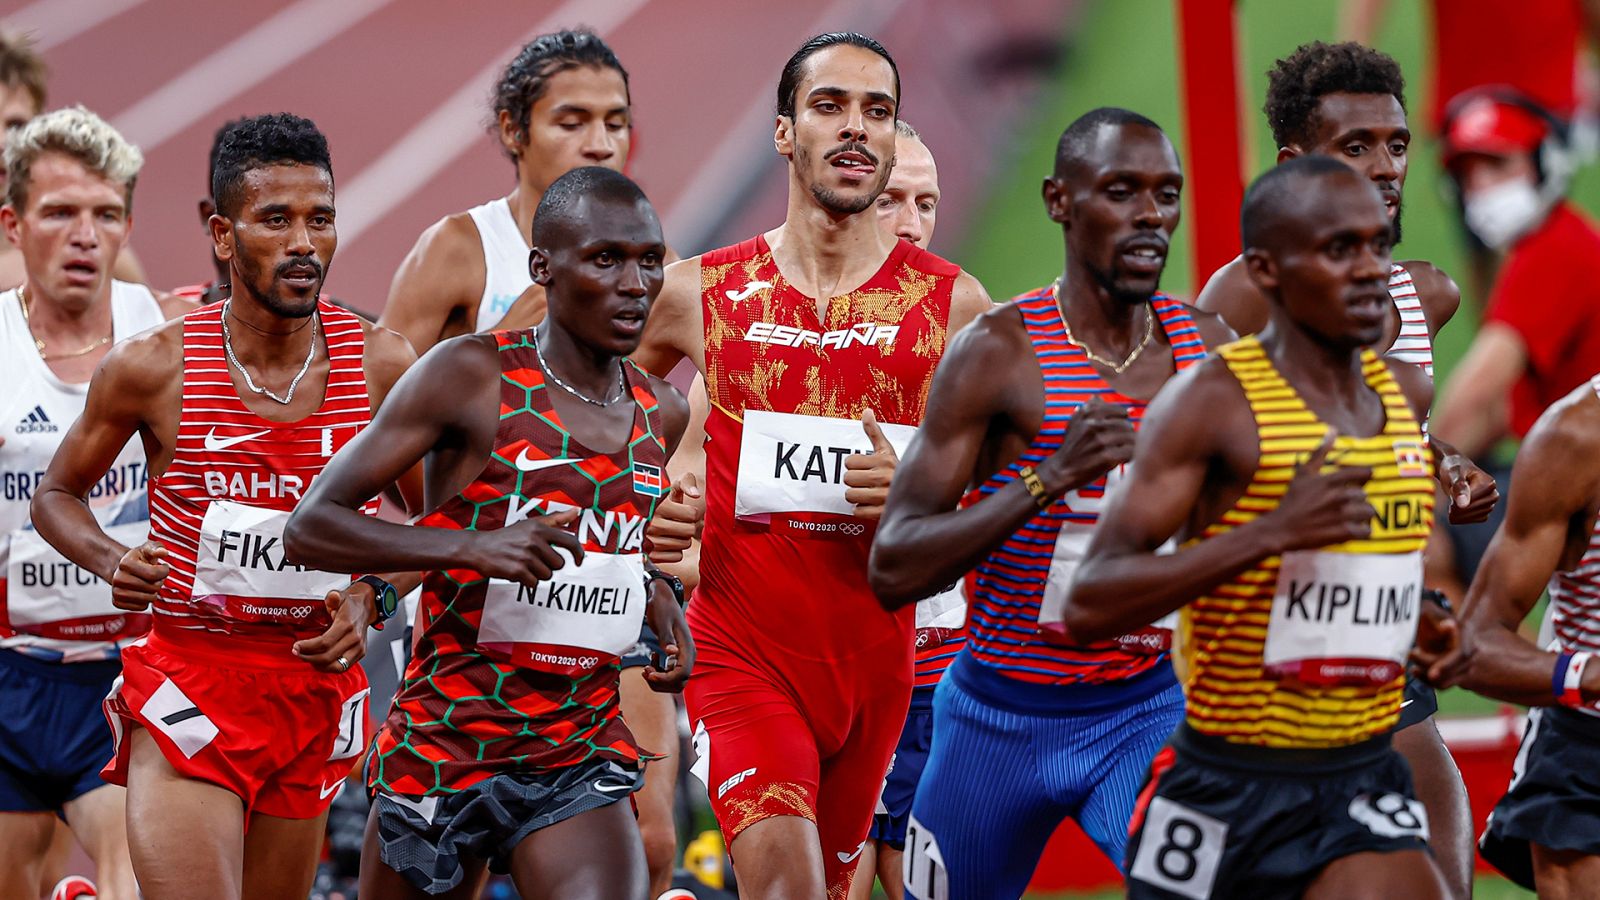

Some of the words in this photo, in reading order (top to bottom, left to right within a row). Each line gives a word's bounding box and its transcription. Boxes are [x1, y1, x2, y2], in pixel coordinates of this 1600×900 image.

[744, 322, 900, 350] ESPAÑA
[15, 423, 58, 434] adidas
[774, 441, 874, 485] KAT
[788, 519, 815, 531] TOKYO
[816, 523, 837, 532] 2020
[242, 604, 268, 615] TOKYO
[268, 605, 288, 616] 2020
[516, 580, 630, 616] N.KIMELI
[530, 651, 557, 664] TOKYO
[557, 655, 577, 666] 2020
[718, 767, 757, 800] ESP
[1154, 818, 1204, 882] 8
